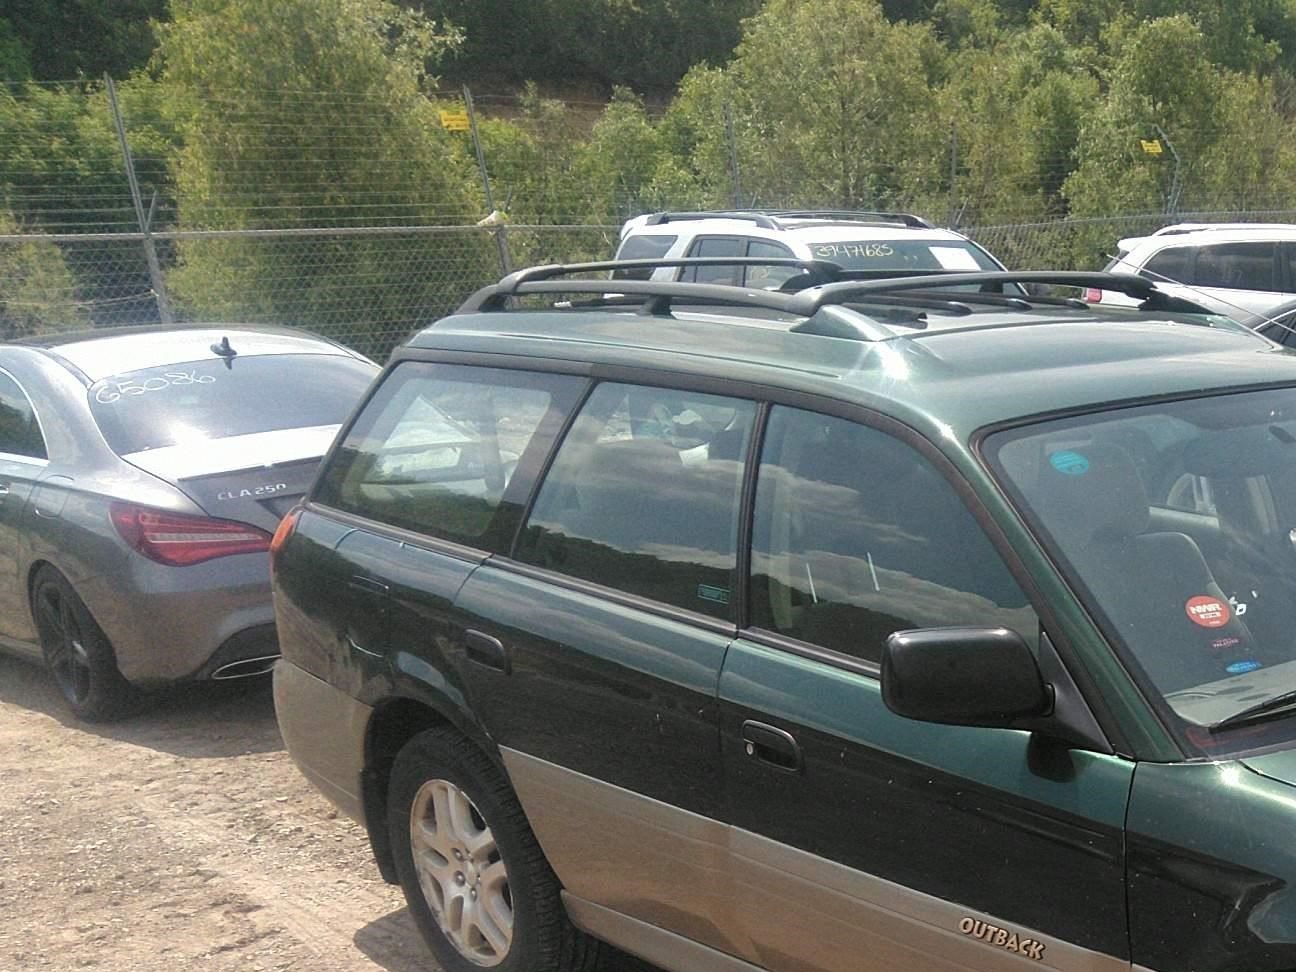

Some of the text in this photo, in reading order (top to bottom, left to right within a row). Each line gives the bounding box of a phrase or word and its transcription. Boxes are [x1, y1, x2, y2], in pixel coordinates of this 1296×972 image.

[217, 483, 287, 500] CLA 250
[959, 917, 1046, 961] OUTBACK
